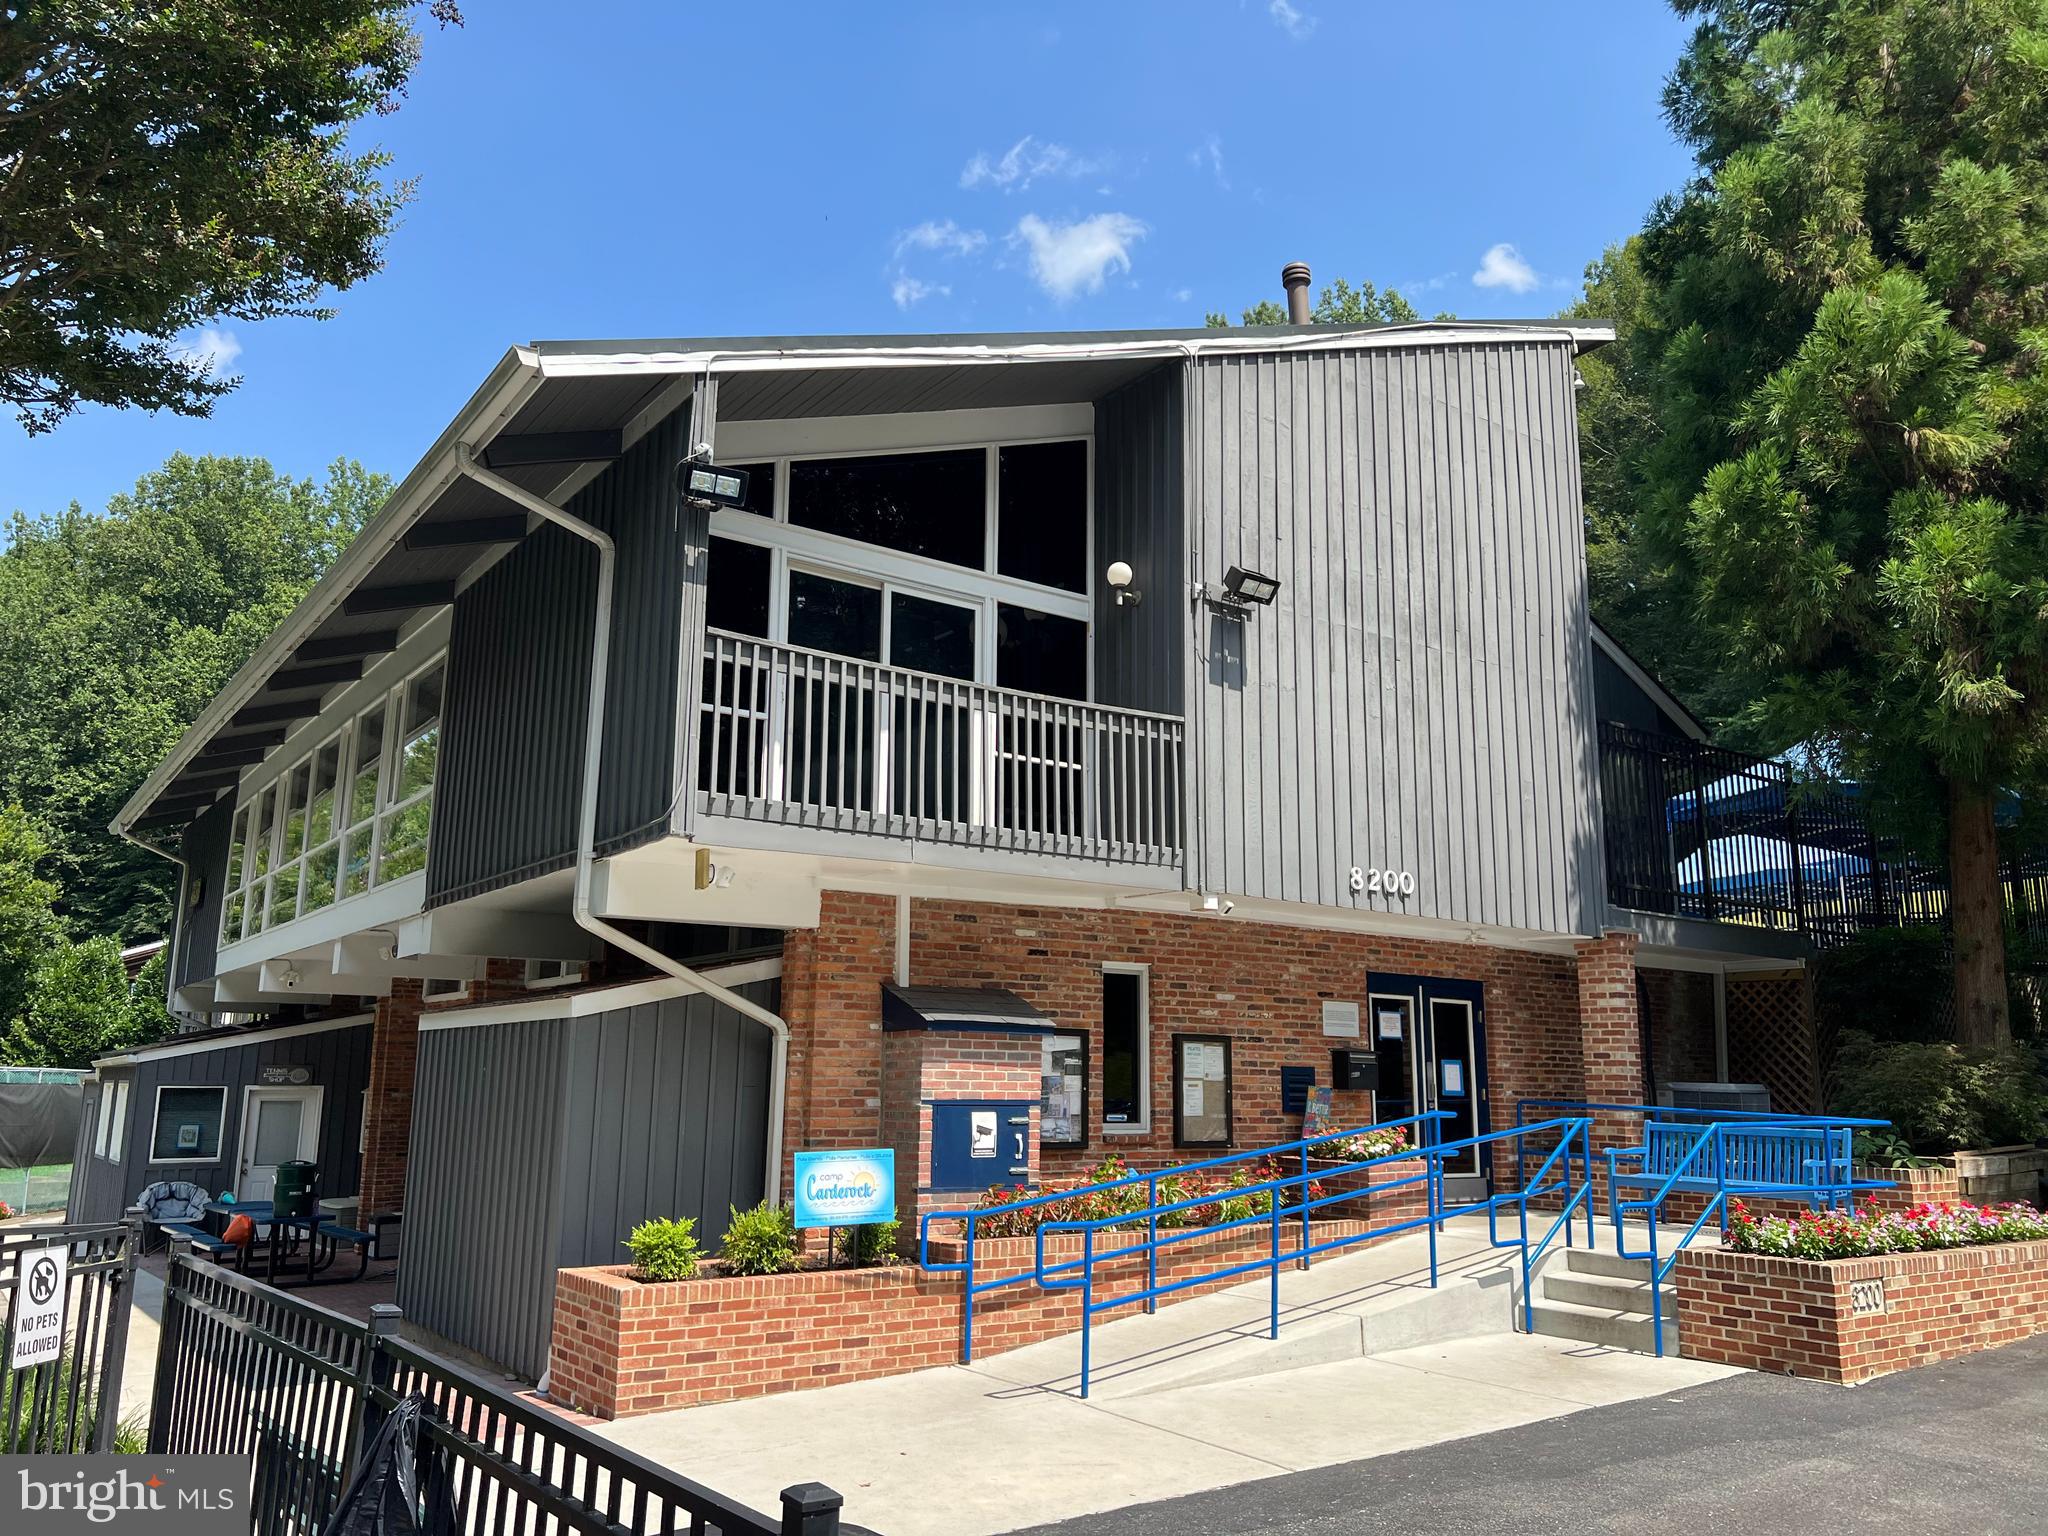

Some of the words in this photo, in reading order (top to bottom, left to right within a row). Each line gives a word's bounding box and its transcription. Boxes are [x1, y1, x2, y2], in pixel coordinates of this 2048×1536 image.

[1350, 866, 1415, 895] 8200
[819, 1173, 844, 1183] camp
[21, 1316, 34, 1333] NO
[36, 1311, 58, 1330] PETS
[16, 1335, 58, 1358] ALLOWED
